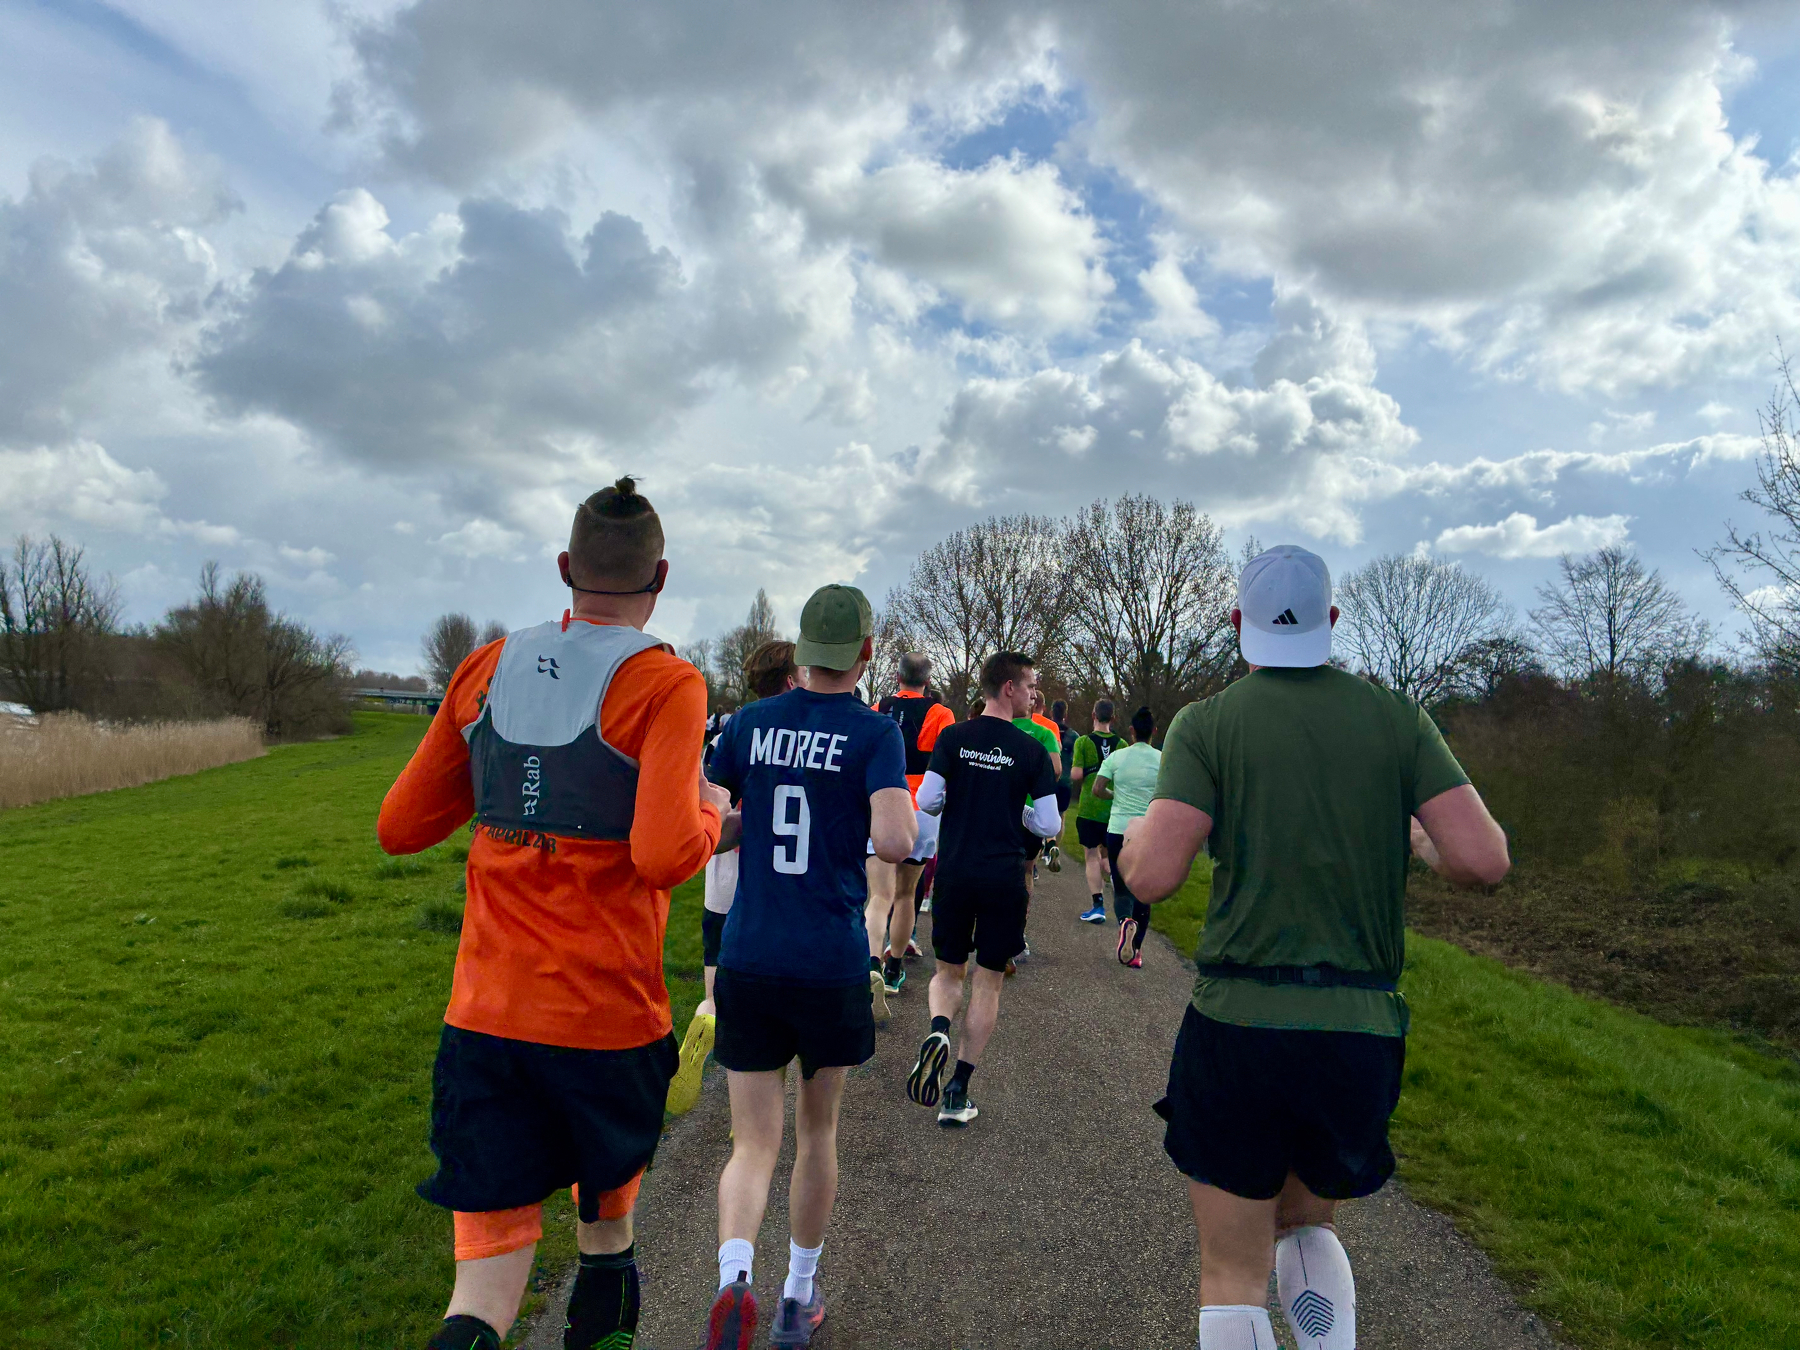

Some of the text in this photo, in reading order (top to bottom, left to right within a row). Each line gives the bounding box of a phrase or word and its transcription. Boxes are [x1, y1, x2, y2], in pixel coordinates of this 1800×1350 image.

[749, 727, 848, 773] MOREE
[522, 755, 540, 798] Rab
[772, 784, 811, 875] 9
